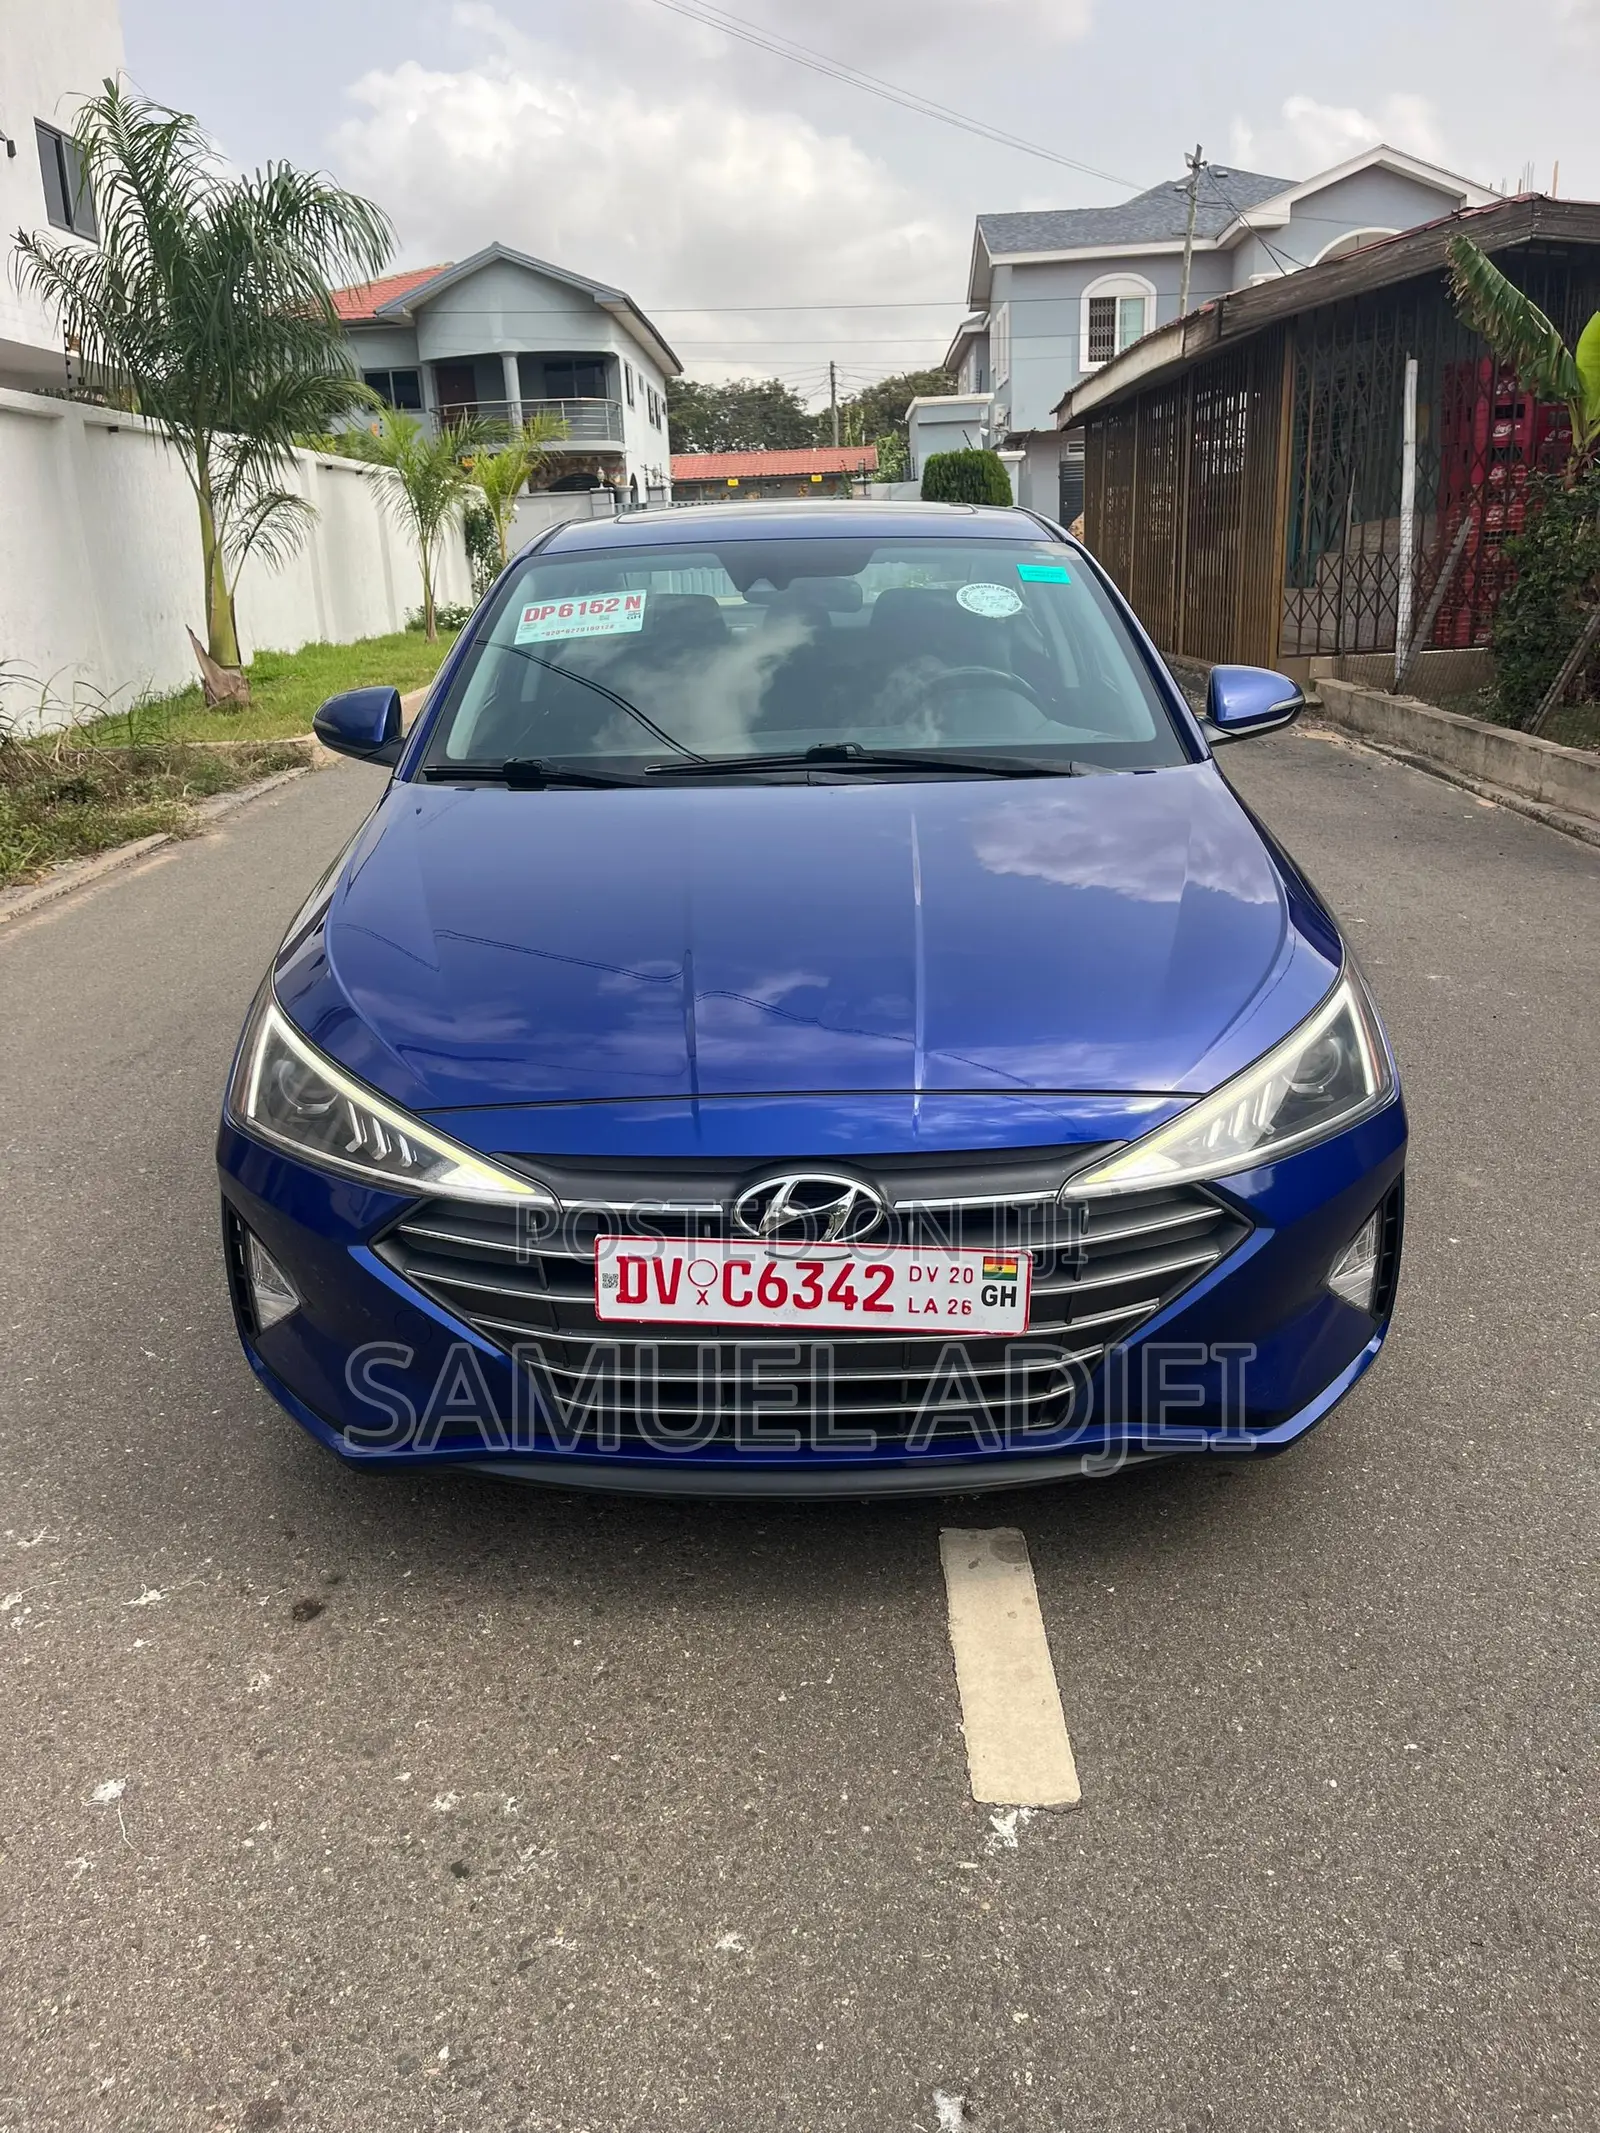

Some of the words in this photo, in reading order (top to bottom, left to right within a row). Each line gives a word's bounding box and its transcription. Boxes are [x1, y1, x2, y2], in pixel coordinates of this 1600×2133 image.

[625, 595, 641, 610] N
[909, 1266, 939, 1283] DV
[949, 1268, 974, 1284] 20
[616, 1256, 682, 1304] DV
[722, 1258, 895, 1313] C6342
[981, 1285, 1017, 1307] GH
[908, 1298, 938, 1314] LA
[947, 1300, 972, 1315] 26
